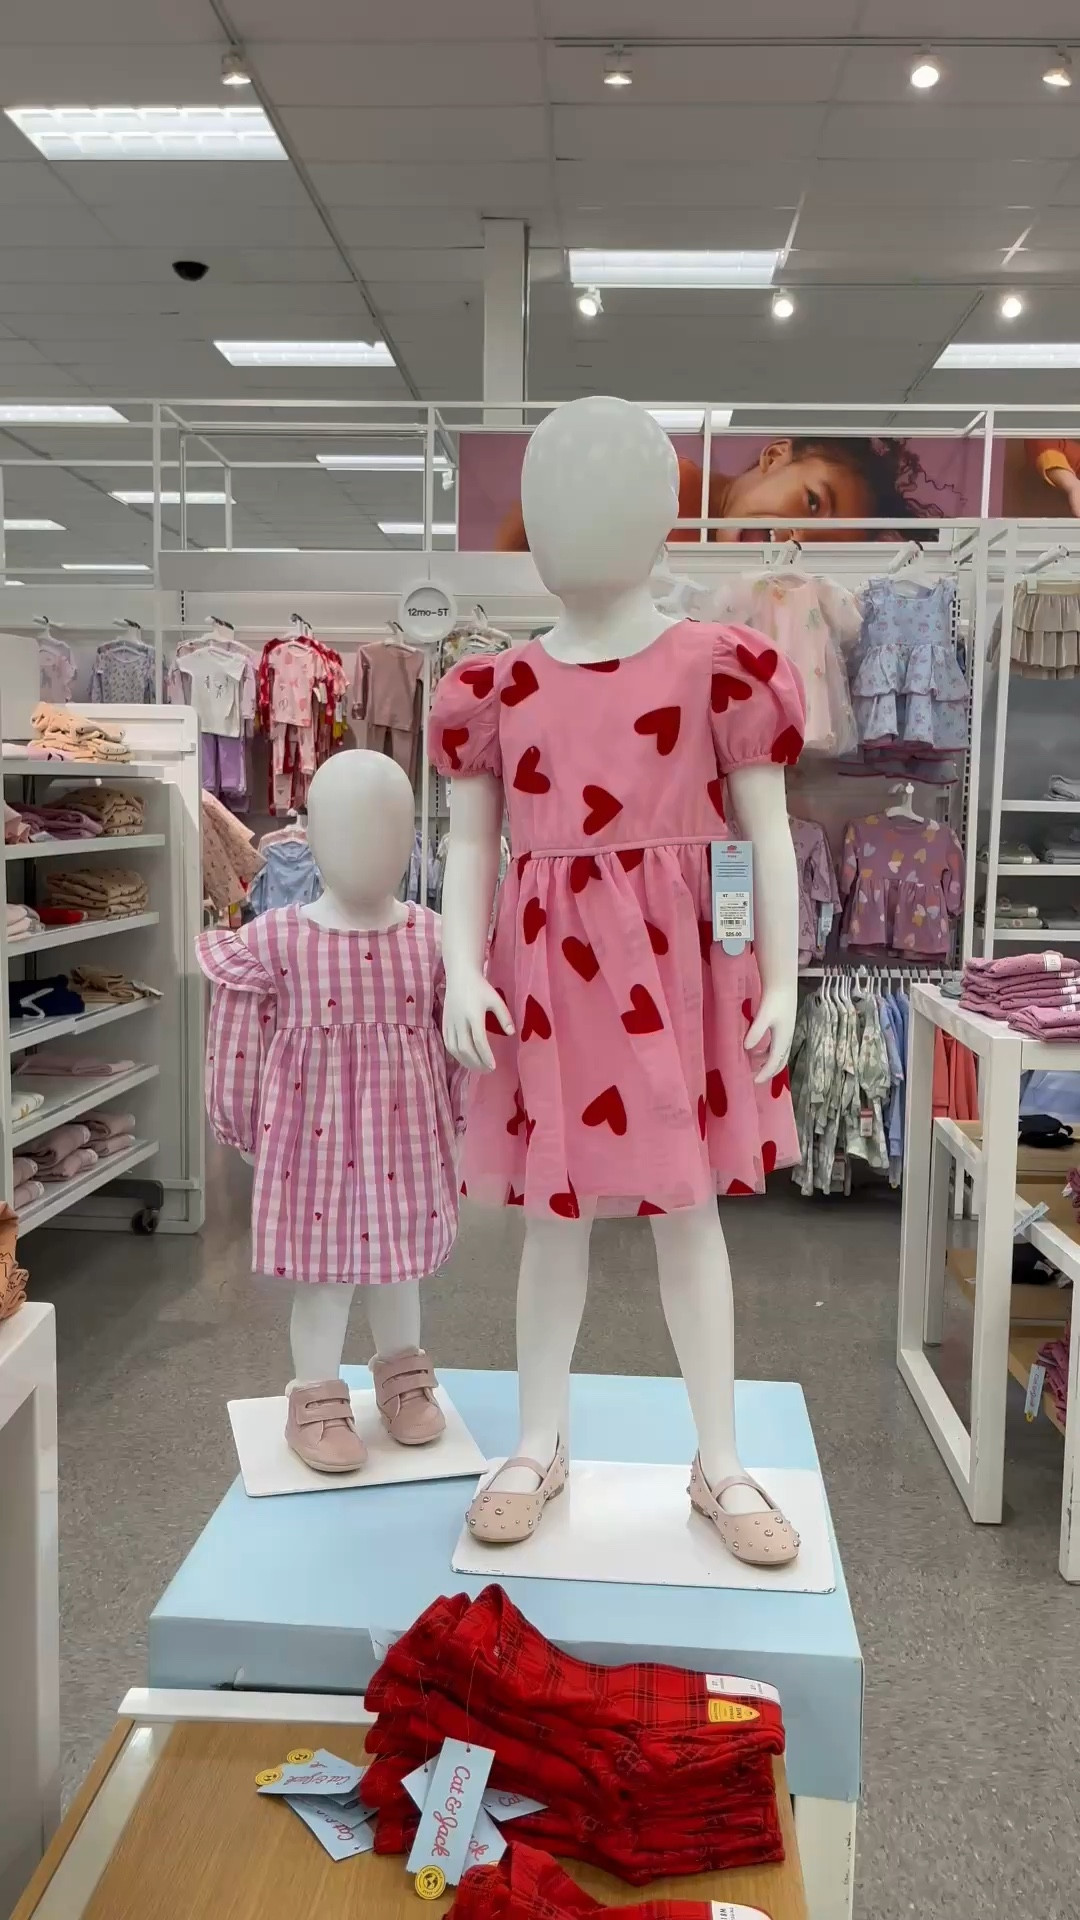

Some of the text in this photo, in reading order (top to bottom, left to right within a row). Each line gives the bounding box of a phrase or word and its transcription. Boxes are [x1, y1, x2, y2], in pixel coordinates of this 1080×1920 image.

[332, 1823, 355, 1841] Cat
[431, 1765, 471, 1857] Cat & Jack
